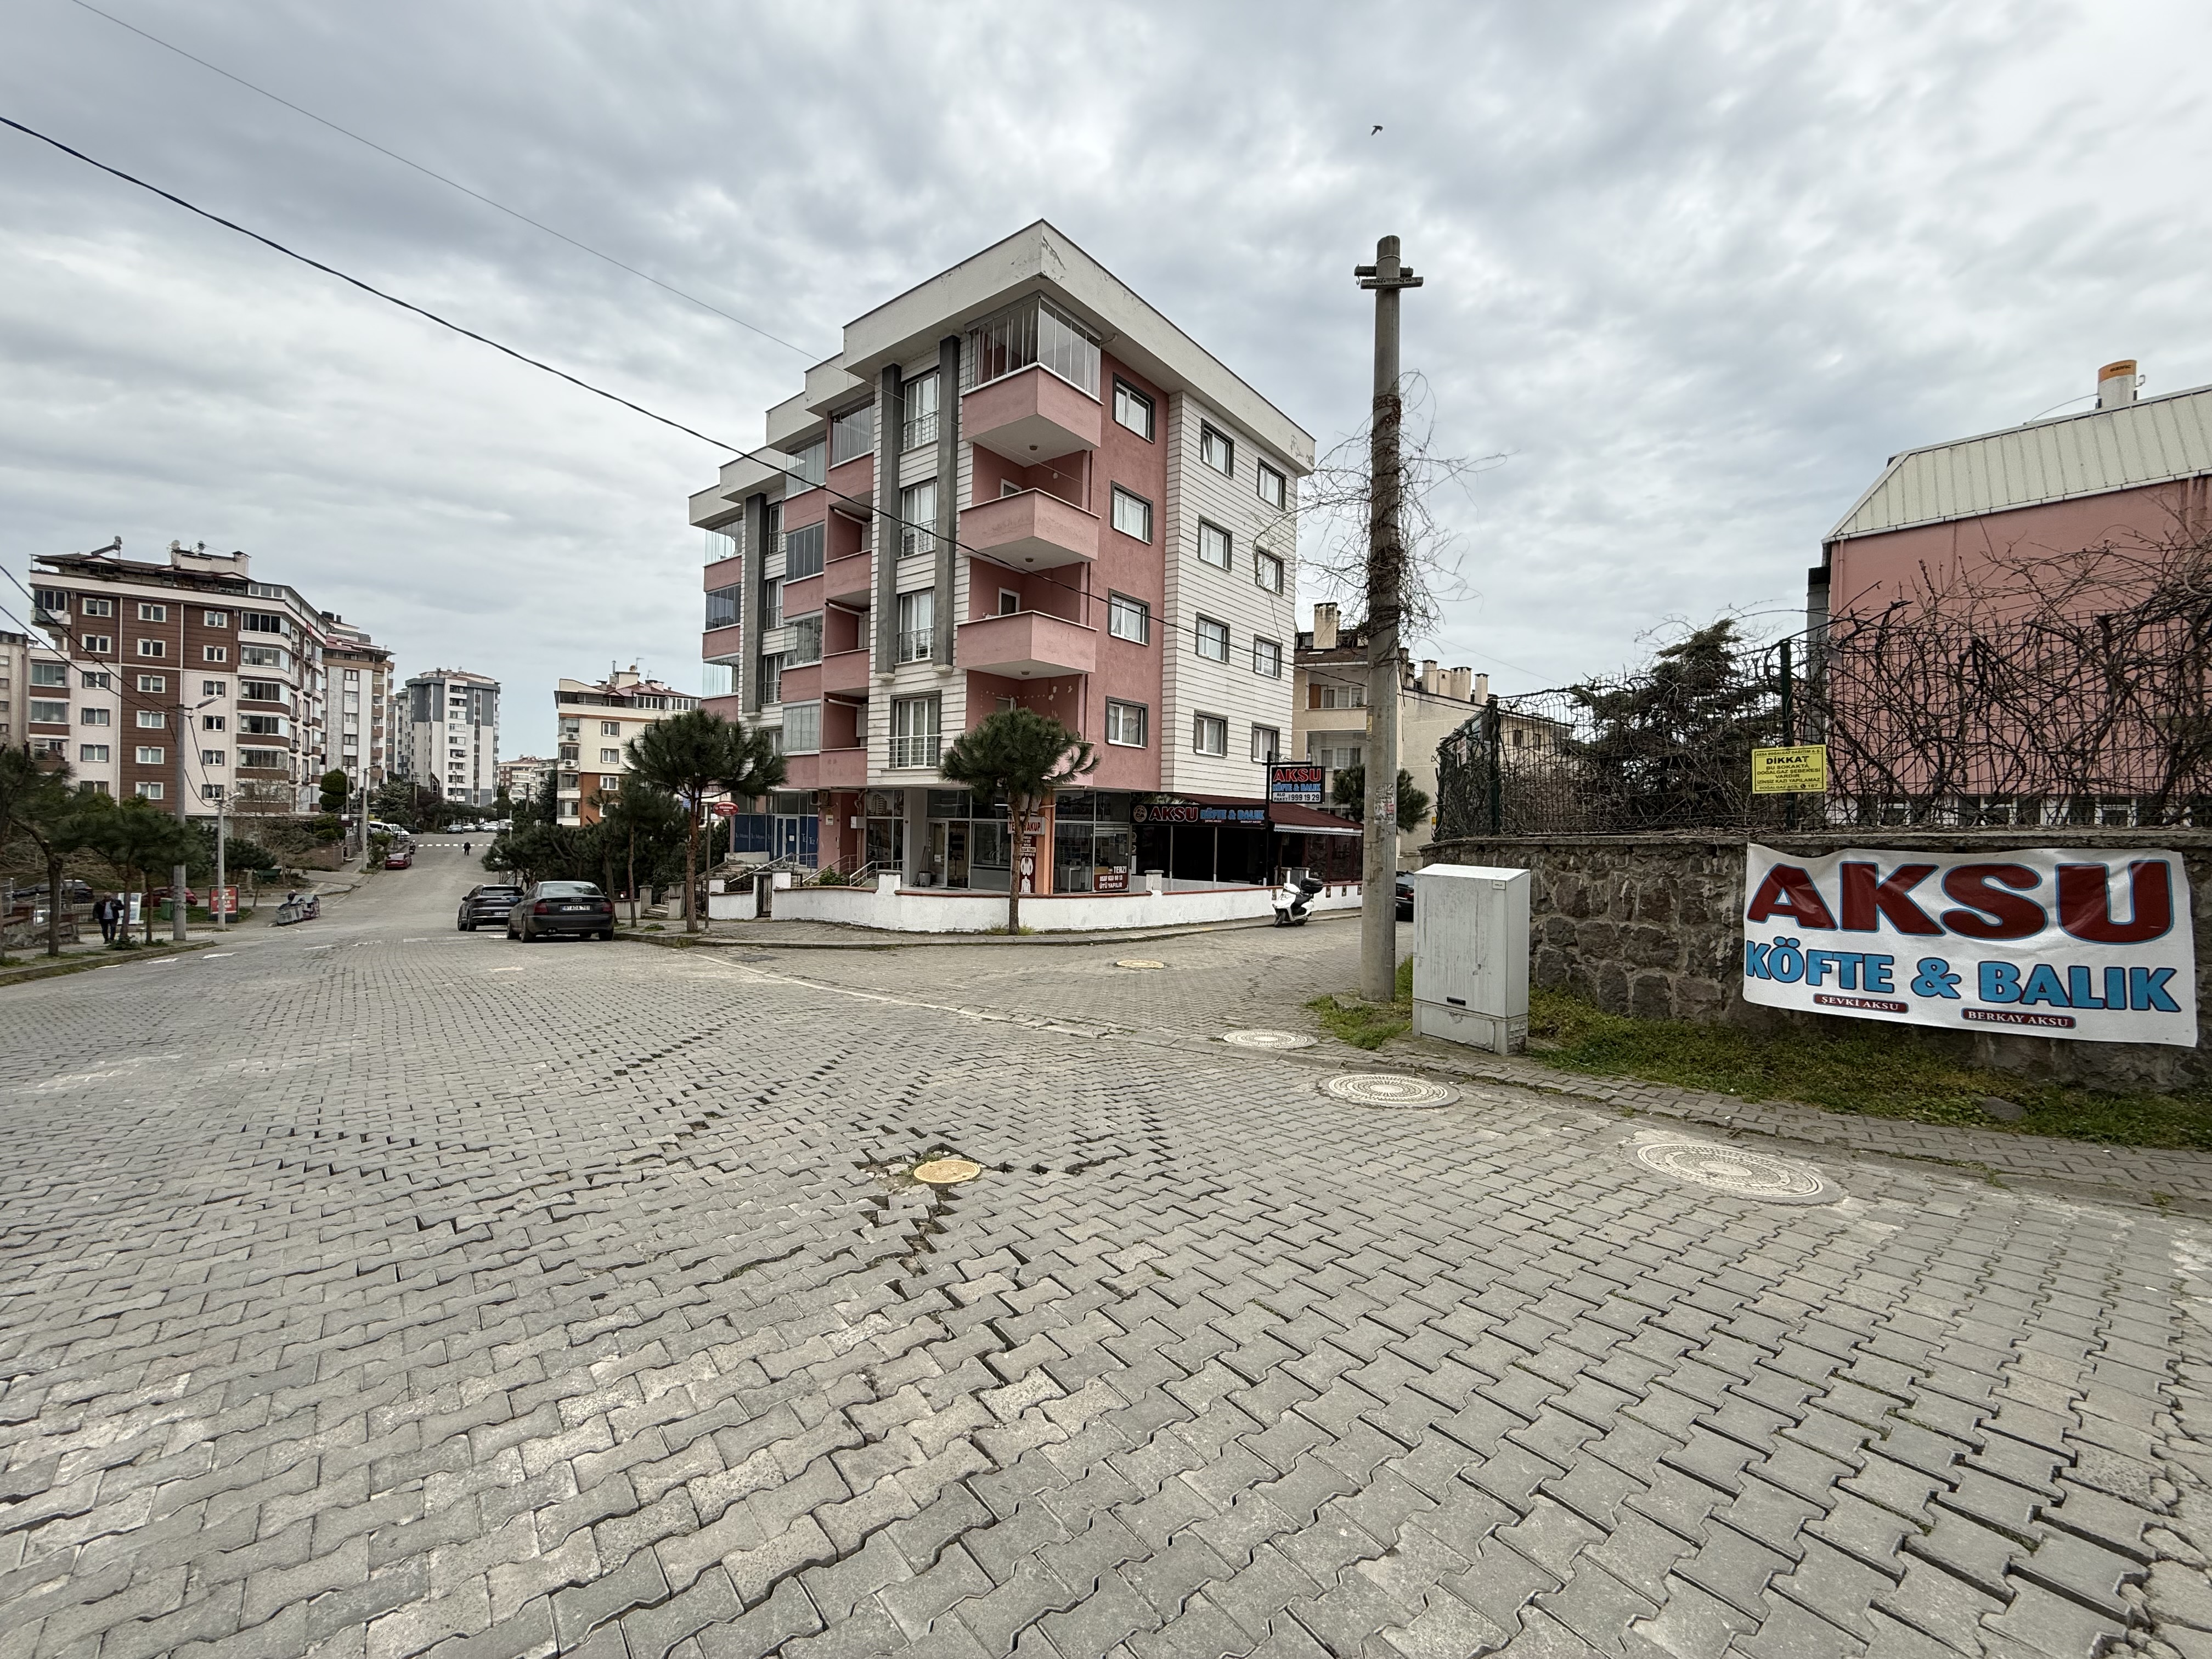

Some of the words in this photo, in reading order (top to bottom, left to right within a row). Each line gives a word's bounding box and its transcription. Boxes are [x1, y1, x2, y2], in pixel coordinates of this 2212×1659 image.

[1766, 756, 1809, 764] DİKKAT
[1273, 769, 1321, 782] AKSU
[1272, 782, 1293, 792] KÖFTE
[1300, 783, 1321, 792] BALIK
[1149, 806, 1198, 822] AKSU
[1200, 808, 1227, 820] KÖFTE
[1228, 809, 1236, 820] &
[1237, 810, 1265, 820] BALIK
[1024, 821, 1041, 831] AKUP
[1747, 860, 2175, 945] AKSU
[1746, 936, 1895, 994] KÖFTE
[1911, 957, 1962, 999] &
[1978, 961, 2182, 1012] BALIK
[1821, 996, 1860, 1006] ŞEVKİ
[1862, 1002, 1899, 1011] AKSU
[1968, 1011, 2024, 1023] BERKAY
[2027, 1017, 2068, 1026] AKSU
